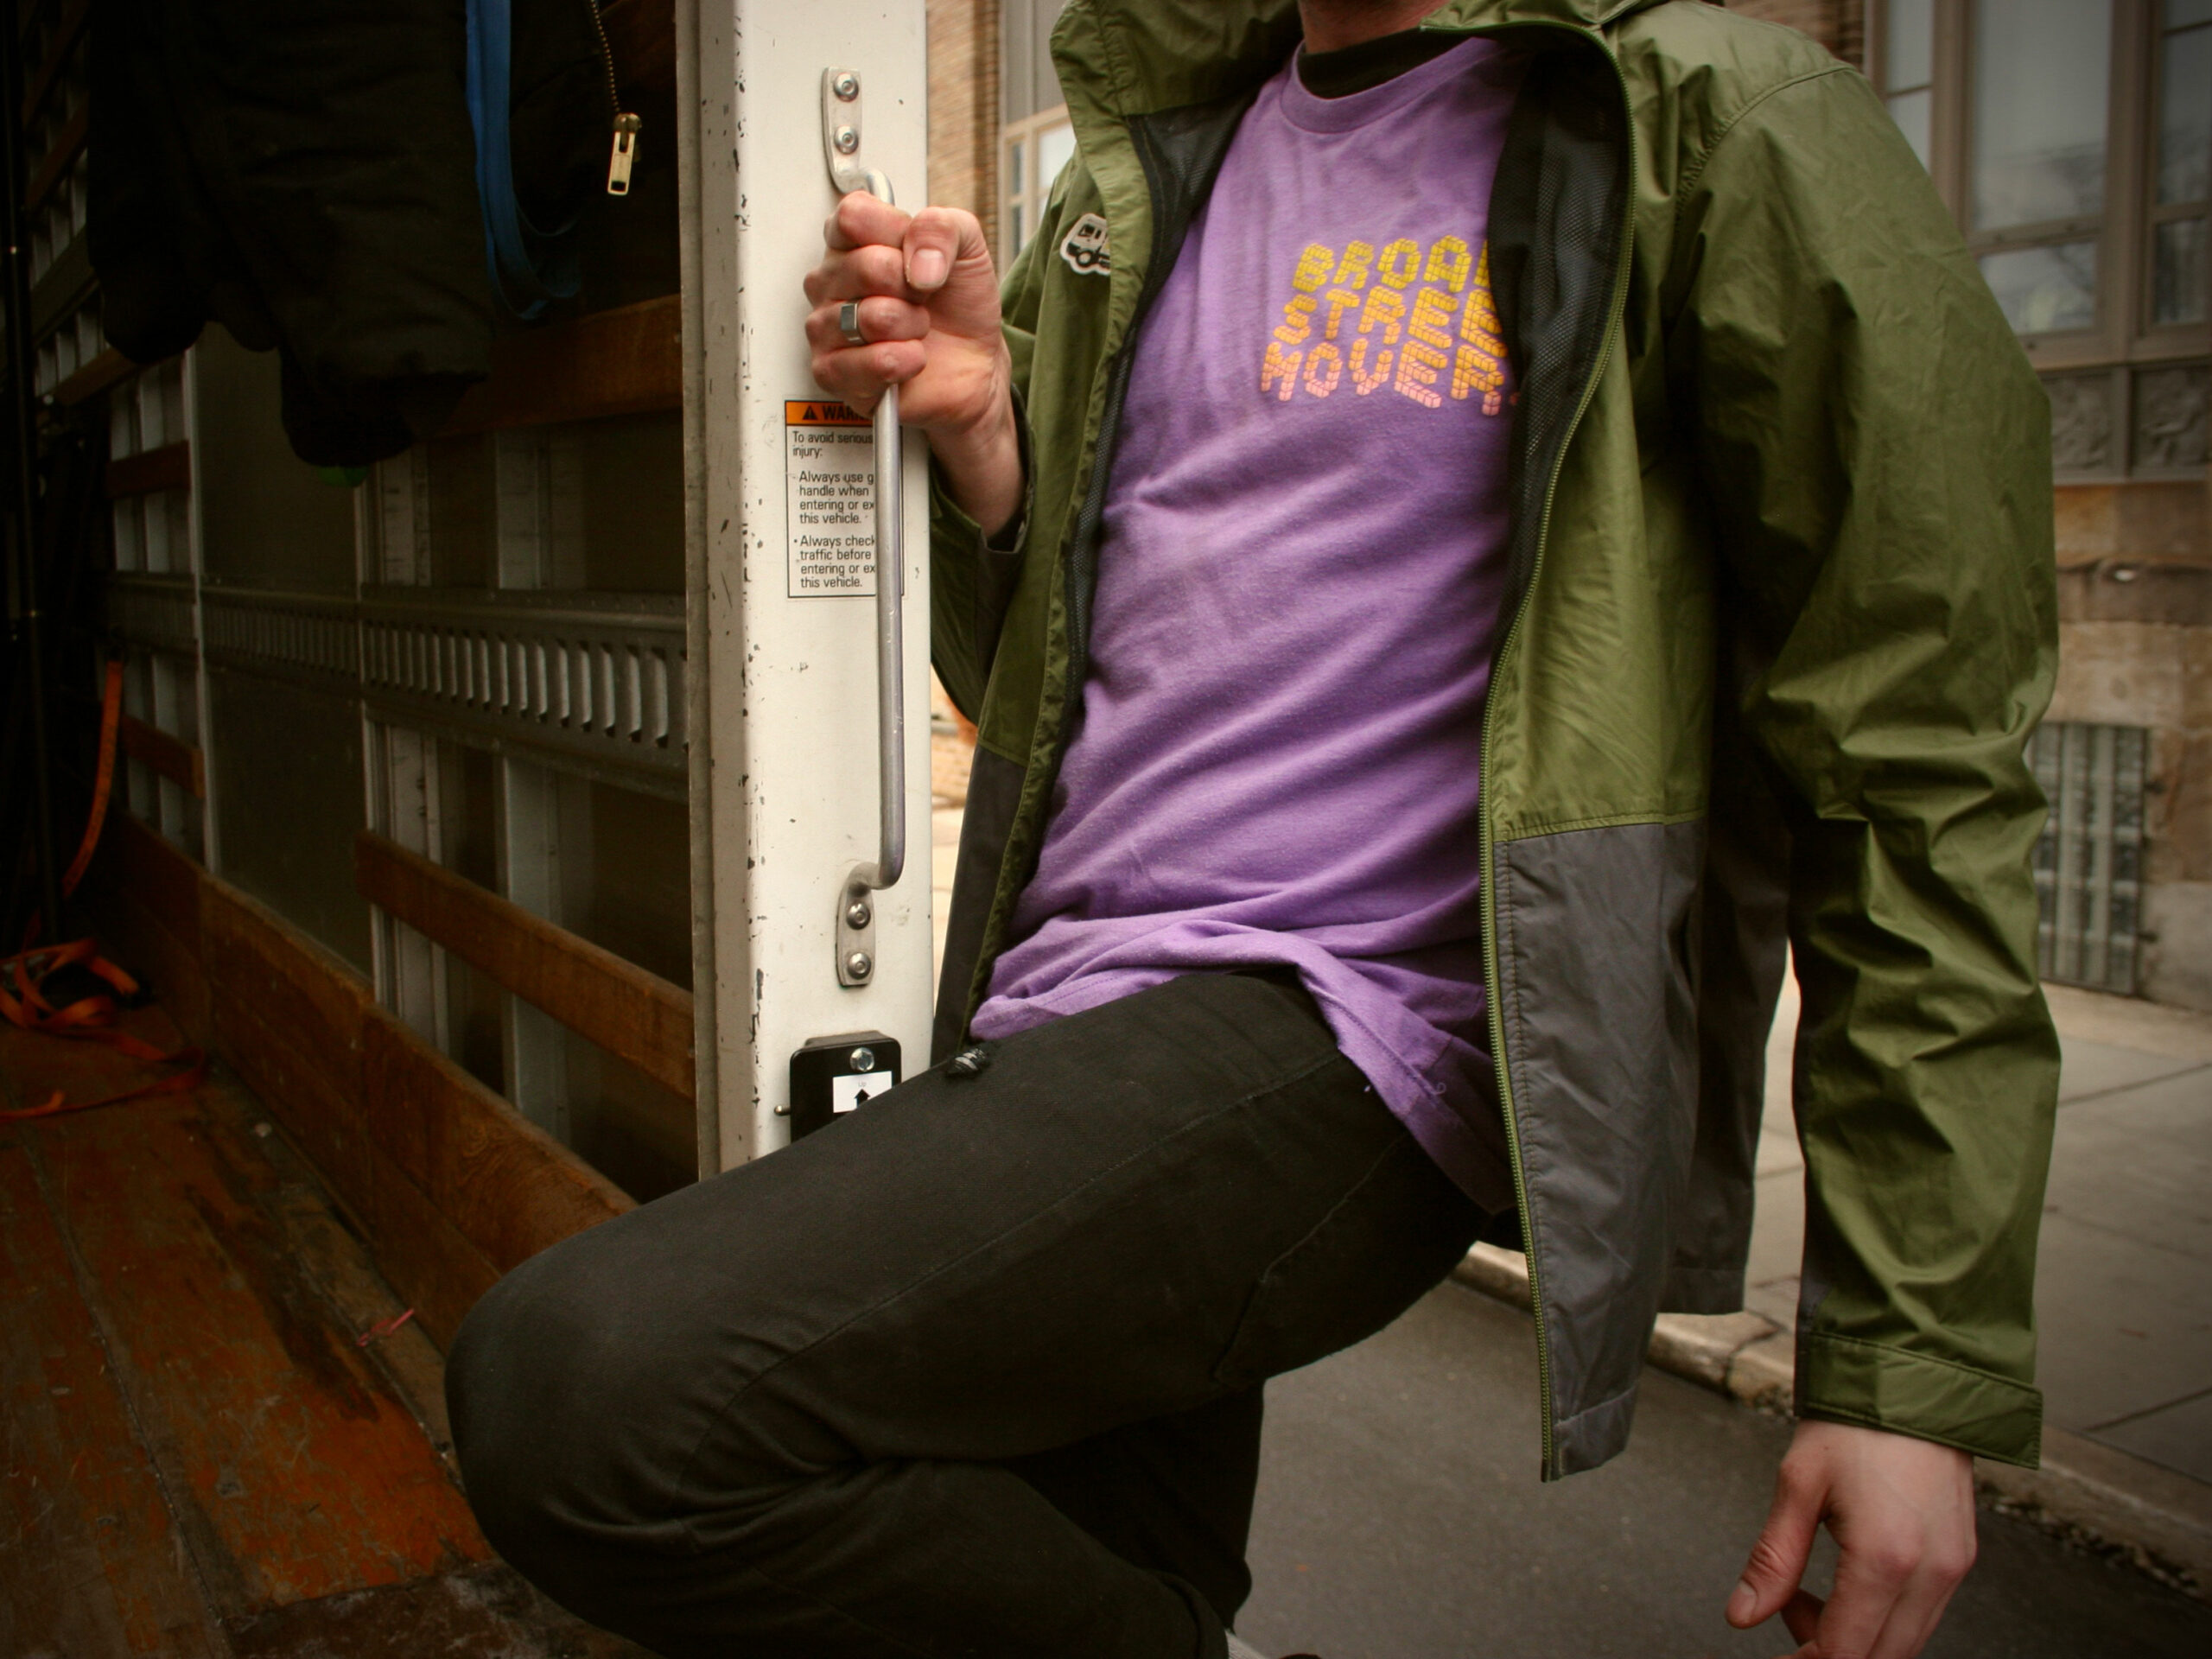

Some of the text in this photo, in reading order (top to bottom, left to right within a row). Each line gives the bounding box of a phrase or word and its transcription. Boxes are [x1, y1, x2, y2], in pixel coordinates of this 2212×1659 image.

[1261, 338, 1520, 416] MOVER
[791, 430, 874, 444] To avoid serious
[792, 444, 823, 460] injury:
[799, 470, 841, 484] Always
[844, 473, 863, 483] use
[799, 485, 869, 496] handle when
[799, 499, 844, 512] entering
[848, 501, 859, 510] or
[799, 512, 862, 524] this vehicle.
[800, 534, 842, 549] Always
[800, 548, 872, 561] traffic before
[800, 563, 845, 576] entering
[849, 564, 860, 574] or
[800, 575, 863, 588] this vehicle.
